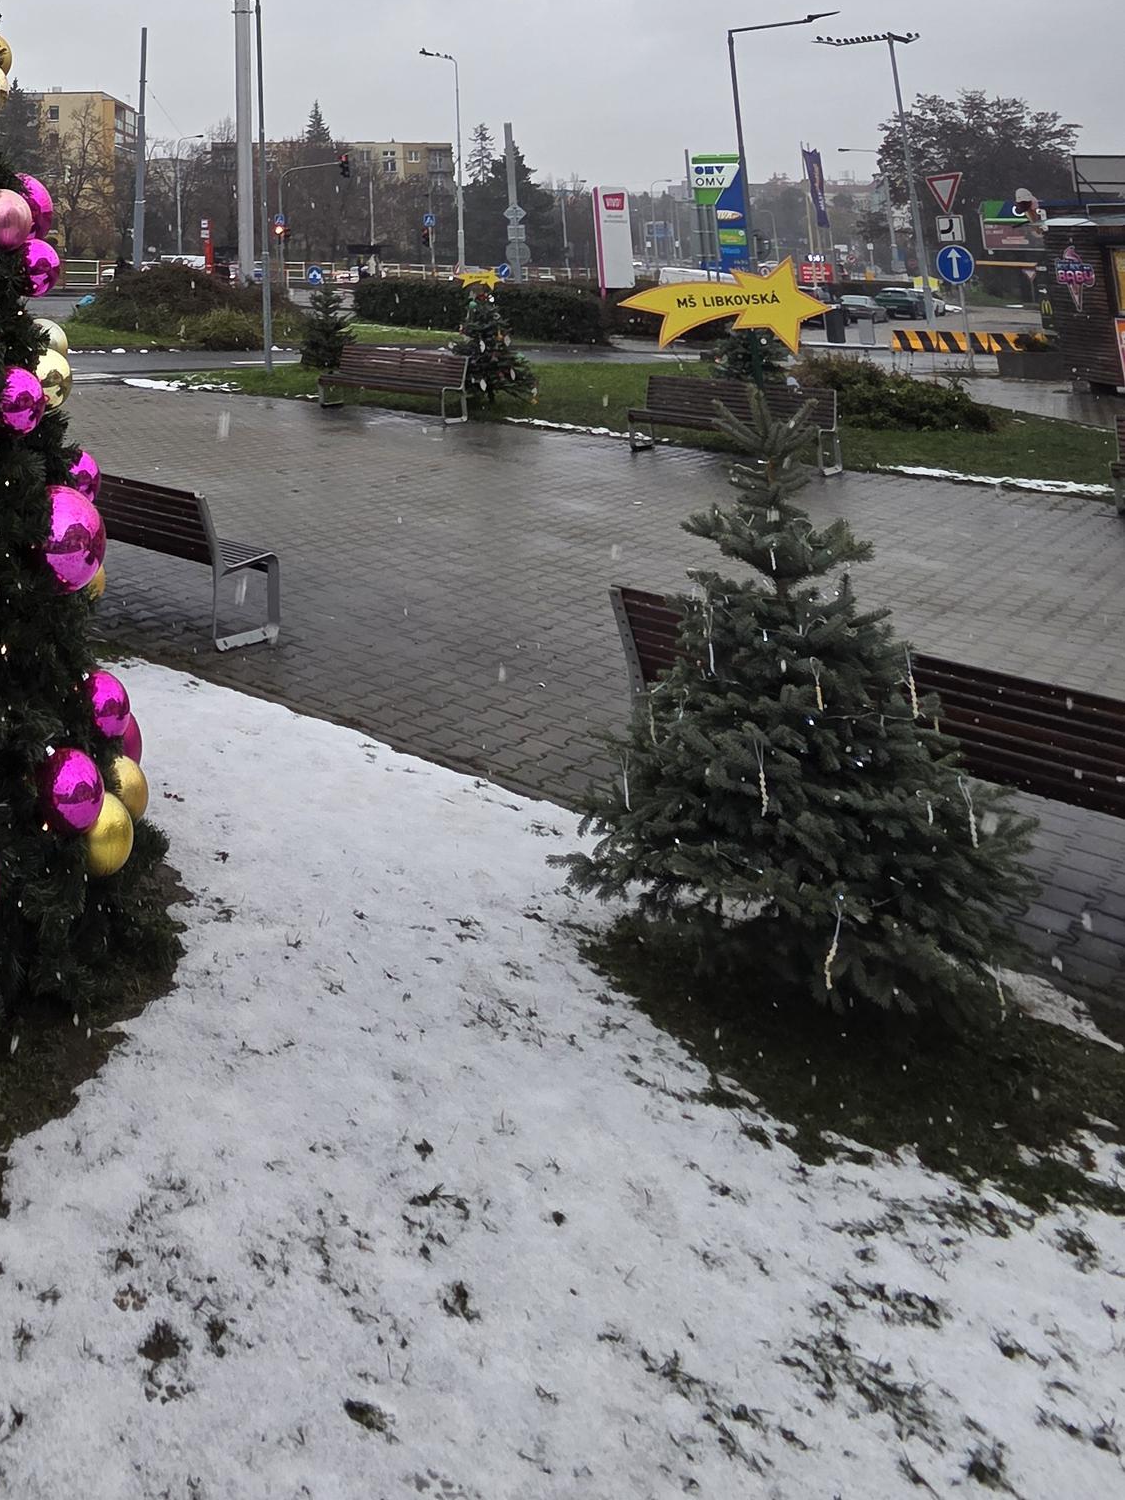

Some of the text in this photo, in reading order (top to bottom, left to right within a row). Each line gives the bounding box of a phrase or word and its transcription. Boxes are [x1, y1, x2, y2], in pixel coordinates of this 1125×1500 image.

[695, 177, 725, 187] OMV
[676, 290, 781, 308] MŠ LIBKOVSKÁ
